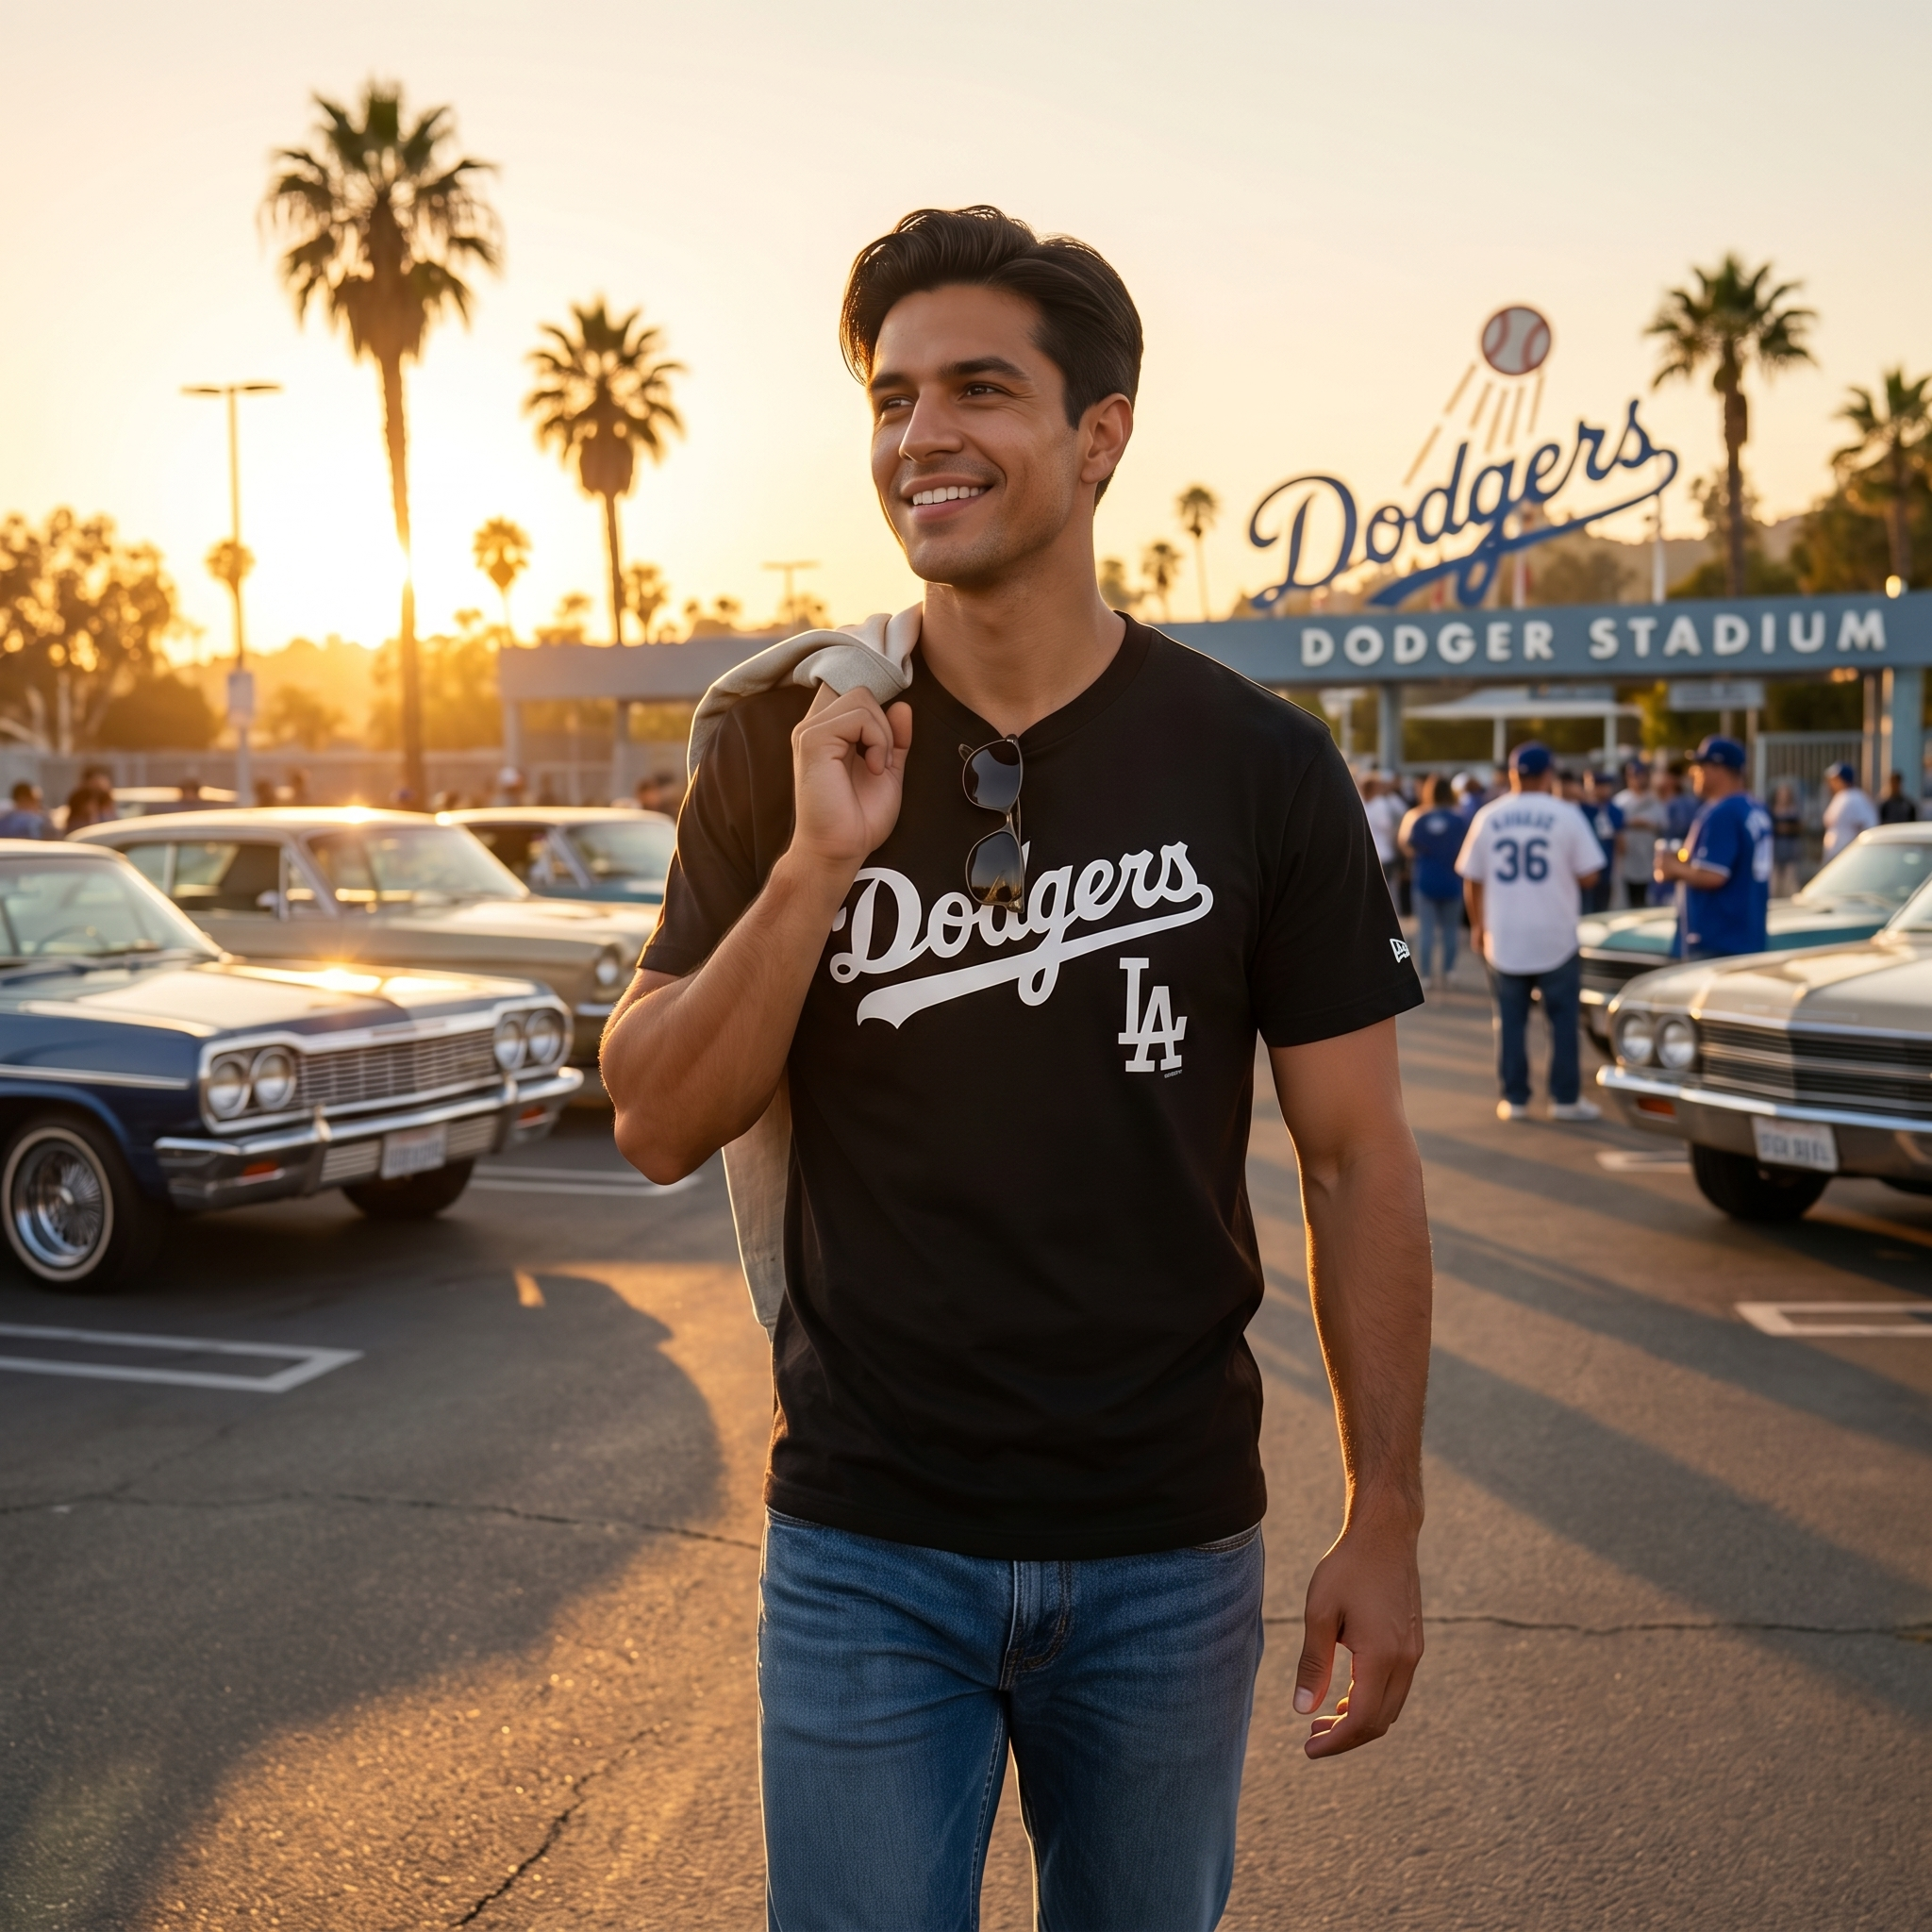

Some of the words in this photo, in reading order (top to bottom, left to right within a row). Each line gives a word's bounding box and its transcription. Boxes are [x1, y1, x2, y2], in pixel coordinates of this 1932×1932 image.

[1249, 400, 1679, 609] Dodgers
[1300, 624, 1554, 666] DODGER
[1589, 609, 1886, 658] STADIUM
[1494, 837, 1550, 882] 36
[1118, 958, 1188, 1073] LA
